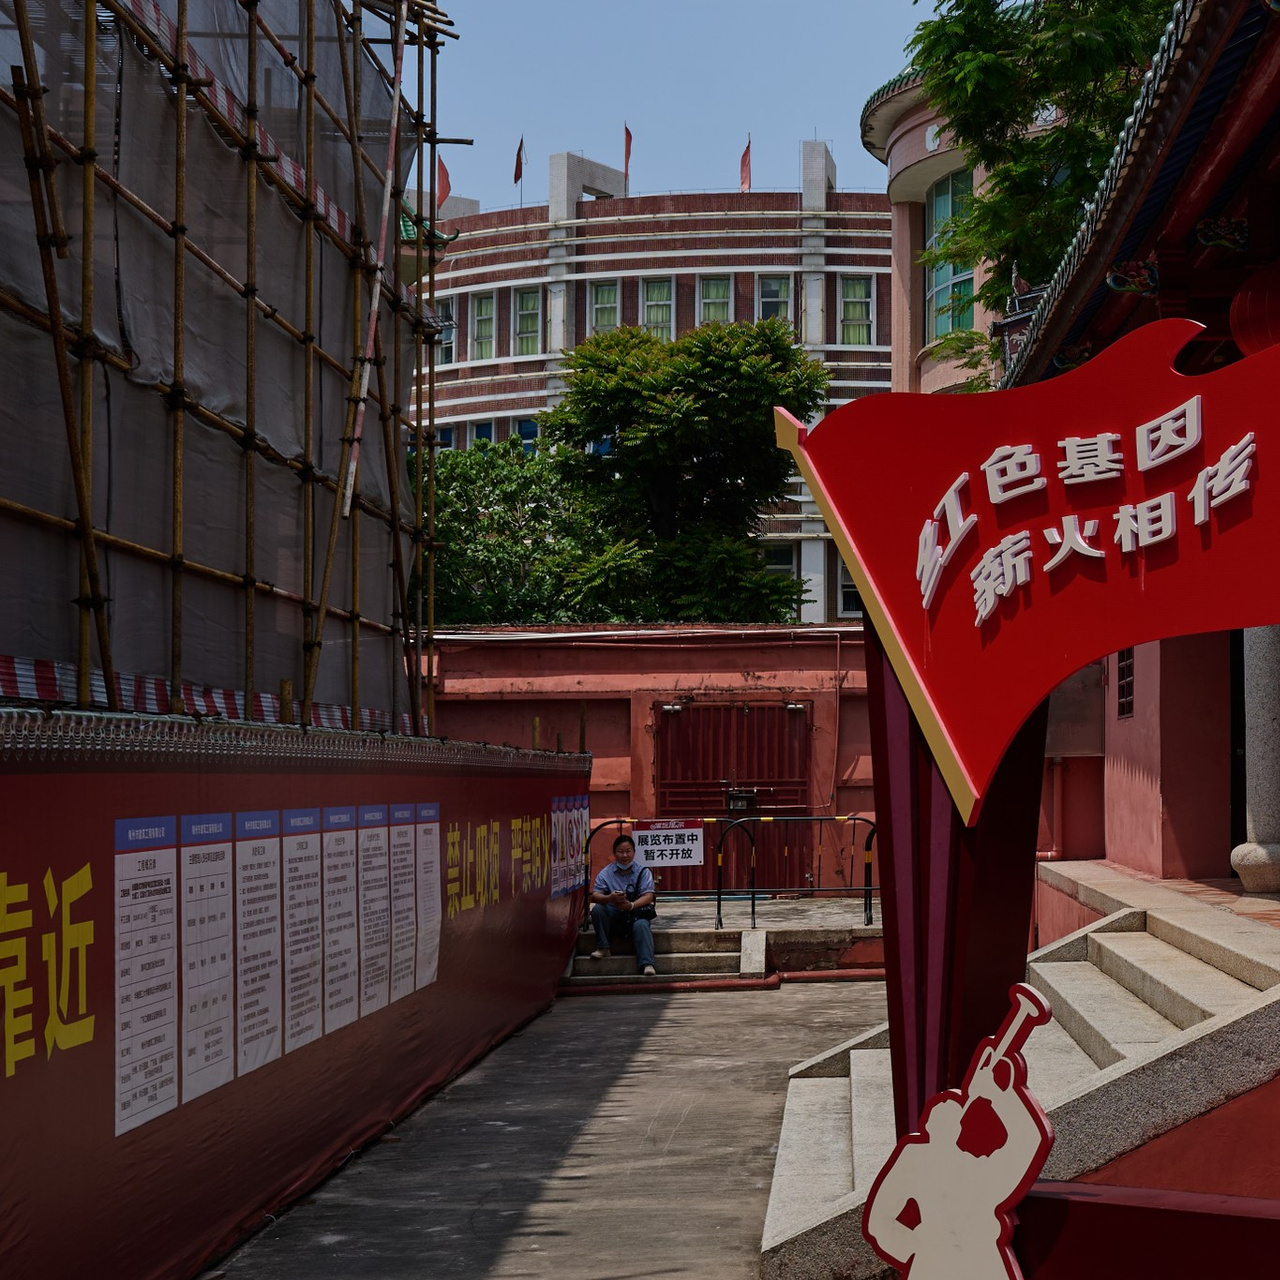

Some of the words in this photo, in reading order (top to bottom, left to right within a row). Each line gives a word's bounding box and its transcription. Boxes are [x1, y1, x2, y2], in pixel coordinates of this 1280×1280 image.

[915, 395, 1204, 610] 红色基因
[970, 431, 1256, 628] 薪火相传
[446, 818, 500, 919] 禁止吸烟
[511, 813, 551, 898] 严禁明火
[637, 832, 699, 847] 展览布置中
[643, 847, 693, 861] 暂不开放
